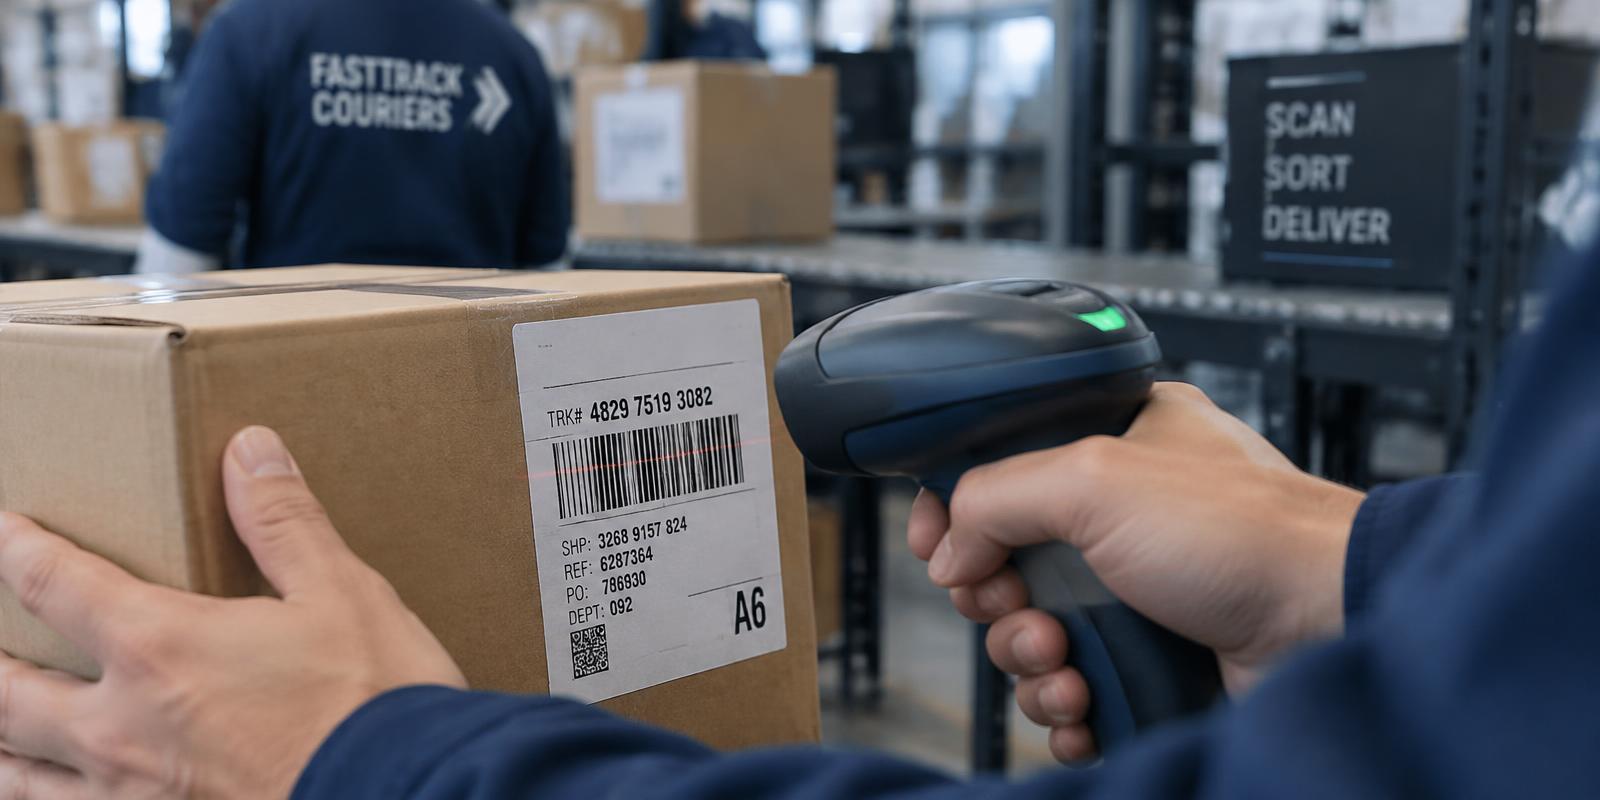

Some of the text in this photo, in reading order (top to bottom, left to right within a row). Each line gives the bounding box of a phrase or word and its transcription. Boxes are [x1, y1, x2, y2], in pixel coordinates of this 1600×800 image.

[310, 53, 463, 96] FASTTRACK
[312, 91, 453, 133] COURIERS
[1265, 101, 1355, 139] SCAN
[1264, 154, 1352, 191] SORT
[1263, 205, 1391, 244] DELIVER
[547, 386, 713, 428] TRK# 4829 7519 3082
[561, 516, 687, 557] SHP: 3268 9157 824
[564, 546, 653, 580] REF: 6287364
[566, 585, 589, 604] PO:
[568, 597, 633, 626] DEPT: 092
[734, 586, 766, 635] A6
